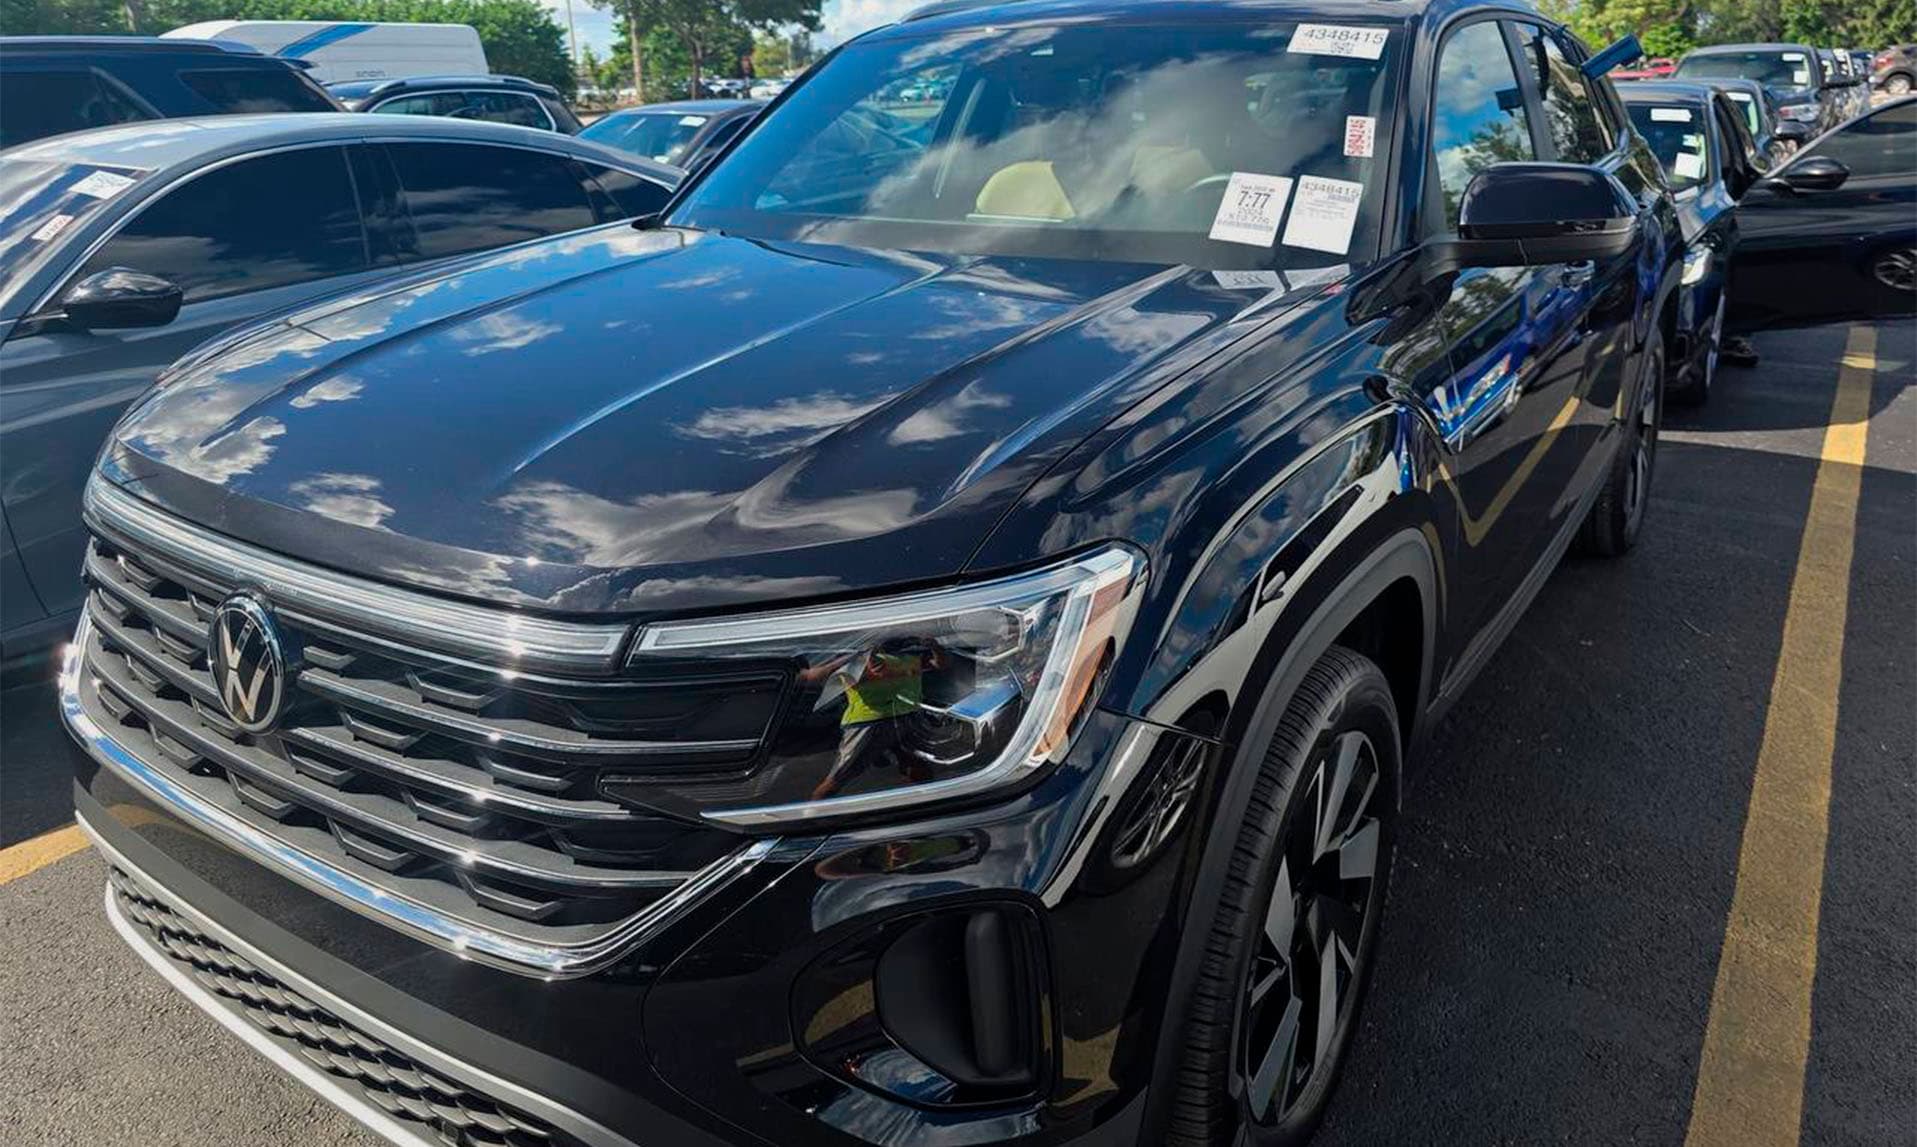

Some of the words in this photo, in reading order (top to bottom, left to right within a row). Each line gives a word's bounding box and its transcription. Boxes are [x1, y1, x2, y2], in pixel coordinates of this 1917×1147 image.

[1303, 28, 1385, 45] 4348415
[1302, 181, 1360, 198] 4348415
[1237, 190, 1272, 209] 7:77
